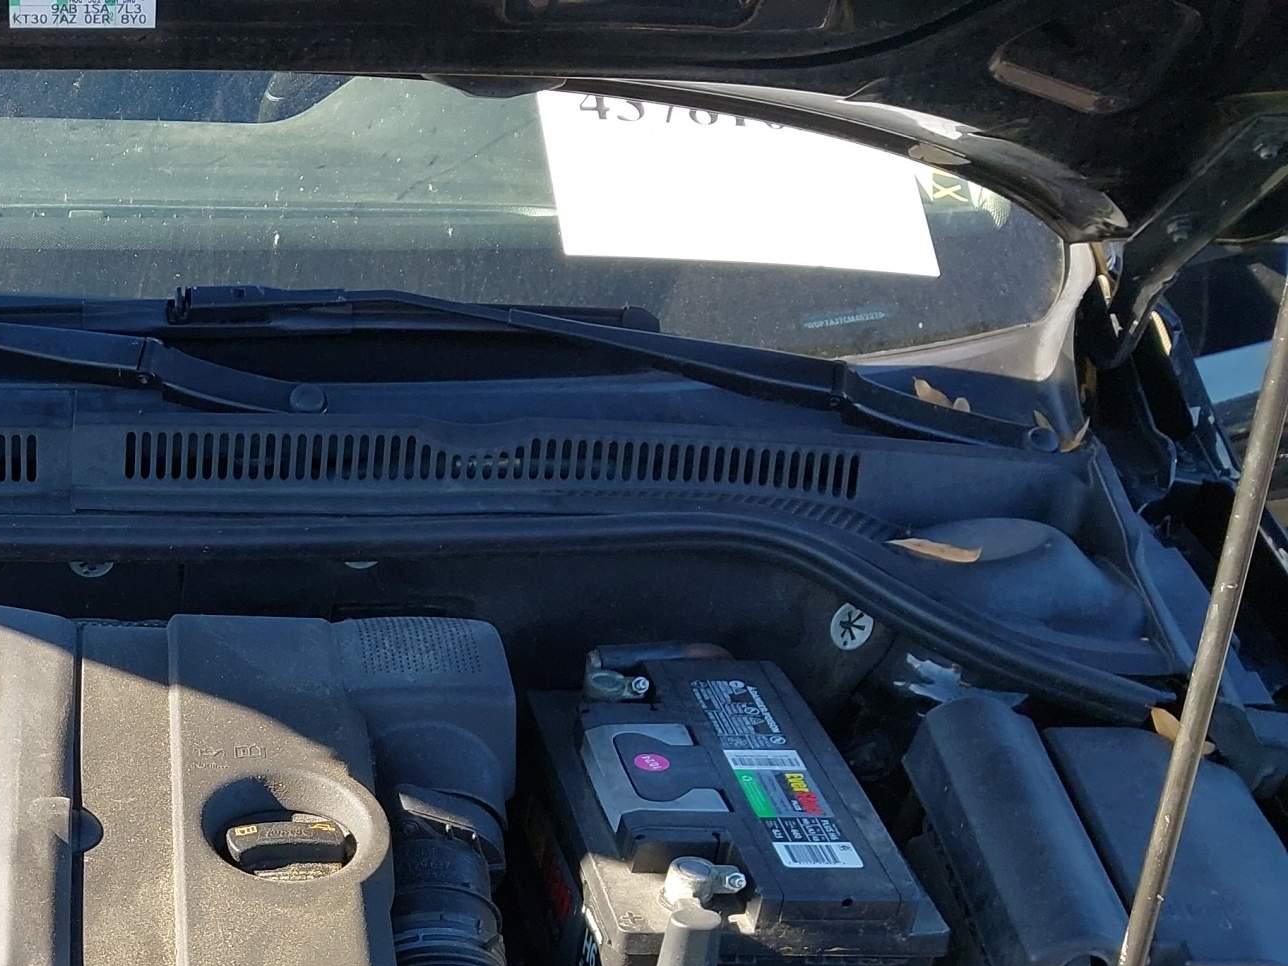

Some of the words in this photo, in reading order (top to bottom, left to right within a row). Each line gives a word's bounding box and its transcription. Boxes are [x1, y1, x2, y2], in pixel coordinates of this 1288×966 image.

[51, 4, 77, 14] 9AB
[117, 4, 142, 14] 7L3
[13, 14, 47, 24] KT30
[52, 14, 77, 24] 7AZ
